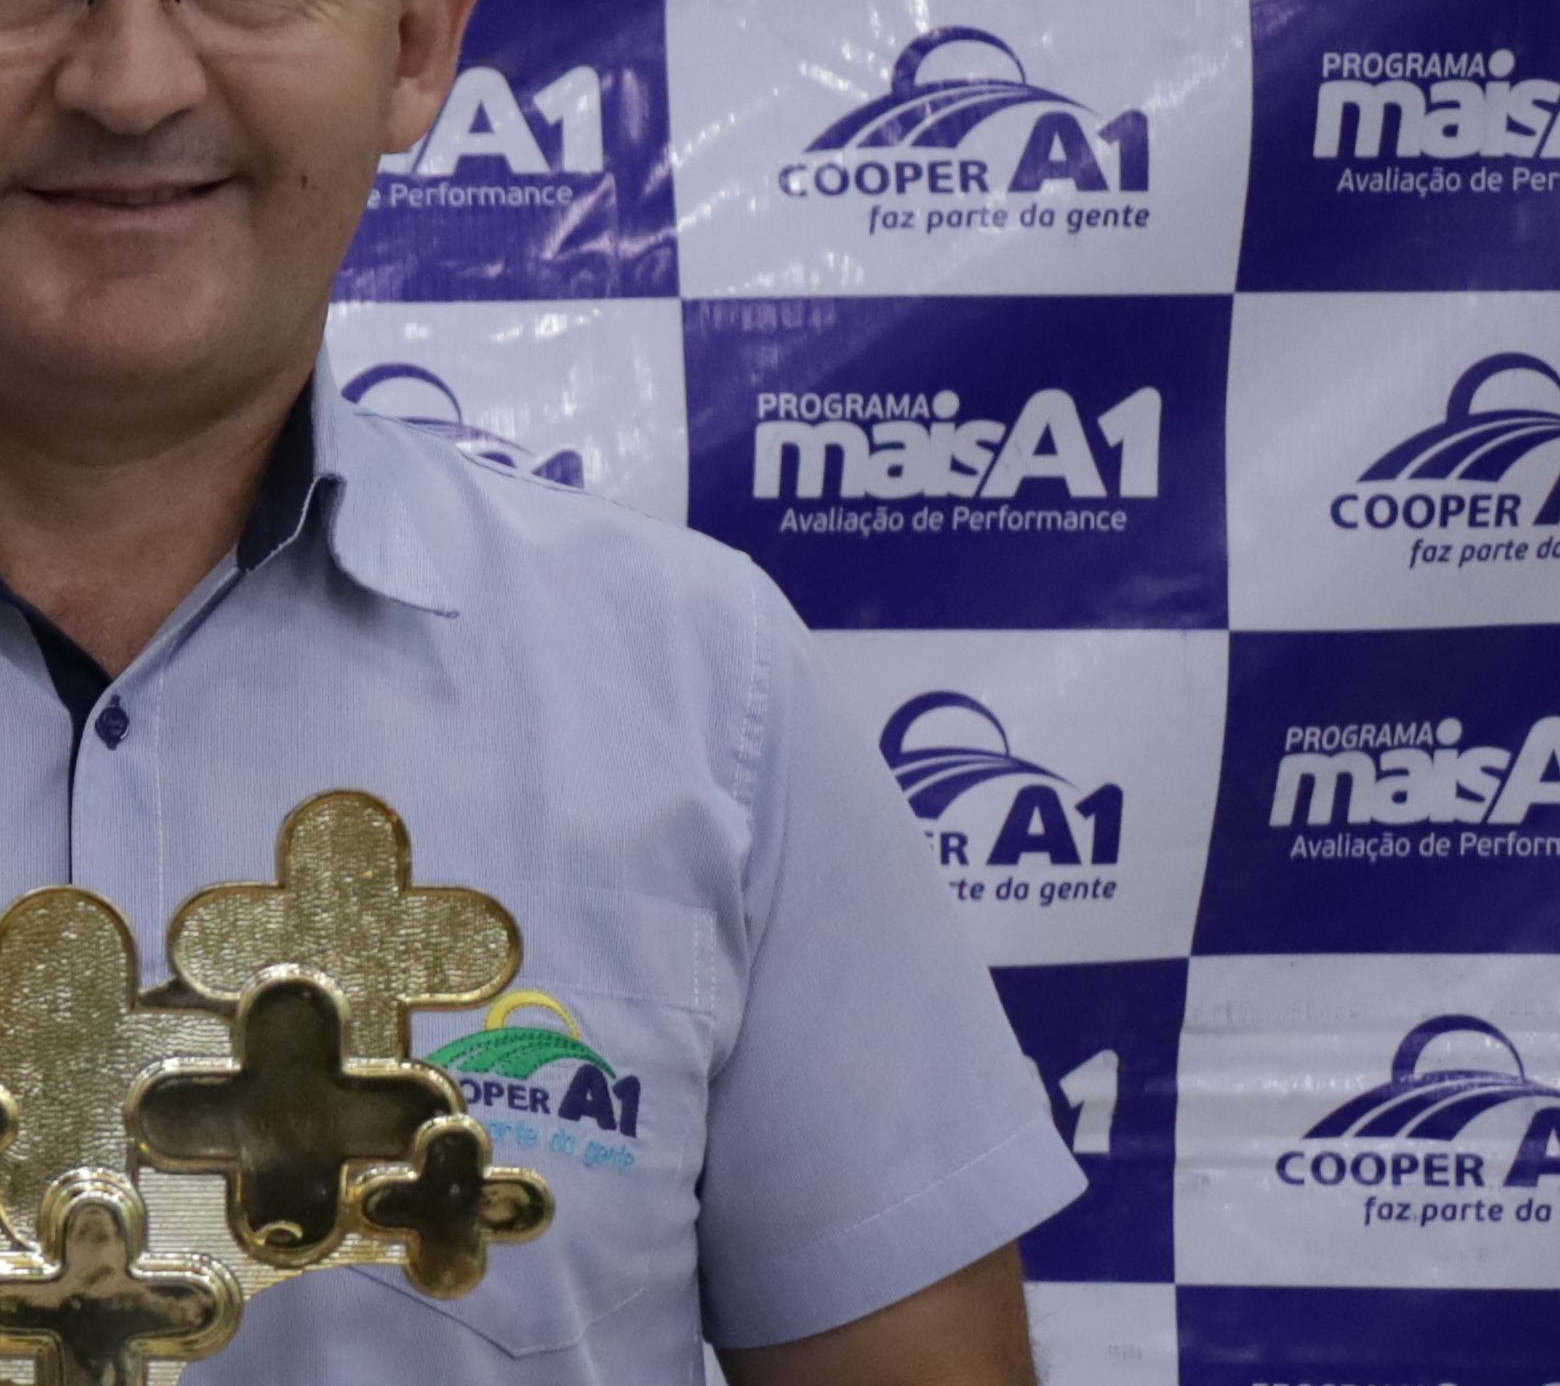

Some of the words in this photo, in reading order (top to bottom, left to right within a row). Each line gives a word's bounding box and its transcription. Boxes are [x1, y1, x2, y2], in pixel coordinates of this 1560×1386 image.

[758, 393, 931, 419] PROGRAMA
[780, 507, 905, 537] Avaliação
[912, 507, 943, 531] de
[952, 505, 1127, 532] Performance
[461, 1079, 551, 1115] OPER
[558, 1063, 640, 1138] A1
[487, 1118, 538, 1146] arte
